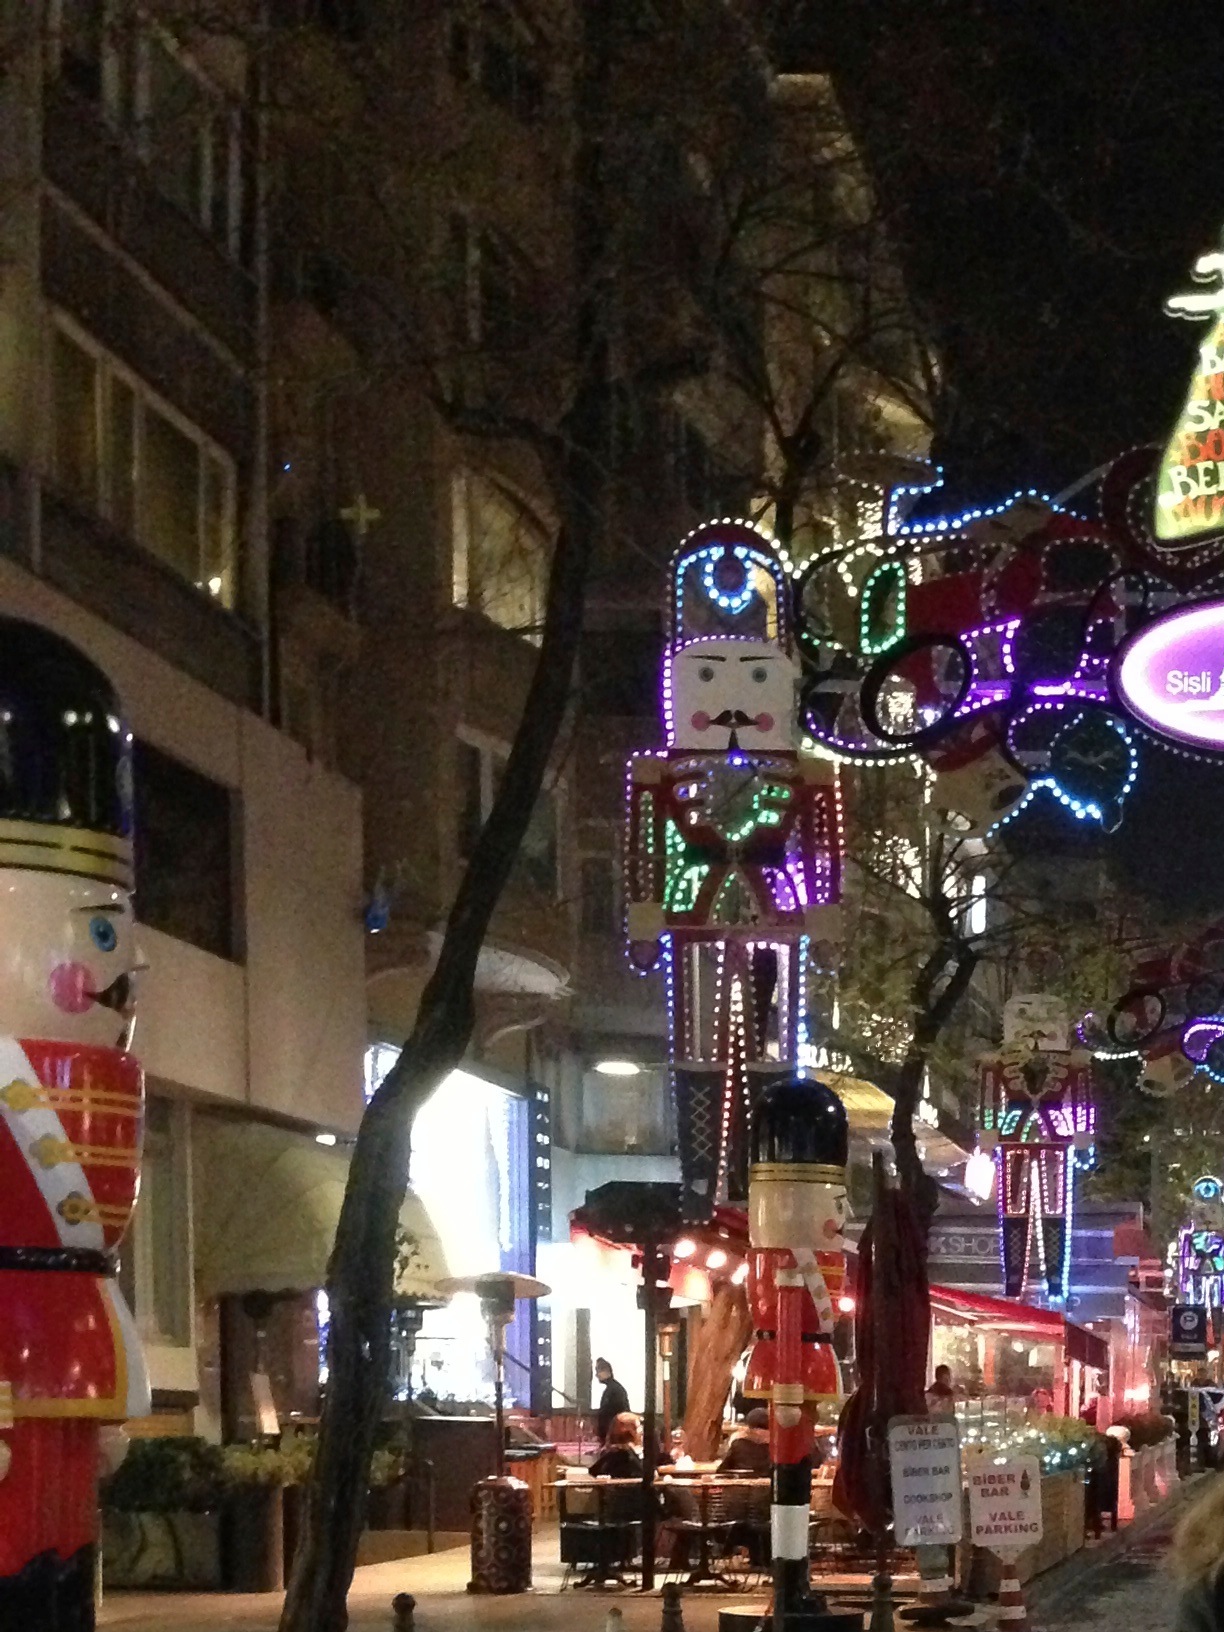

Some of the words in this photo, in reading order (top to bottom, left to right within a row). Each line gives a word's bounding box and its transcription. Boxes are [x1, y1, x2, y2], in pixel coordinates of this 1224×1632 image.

[907, 1425, 939, 1436] VALE
[981, 1486, 1009, 1498] BAR
[989, 1510, 1025, 1522] VALE
[975, 1522, 1039, 1535] PARKING
